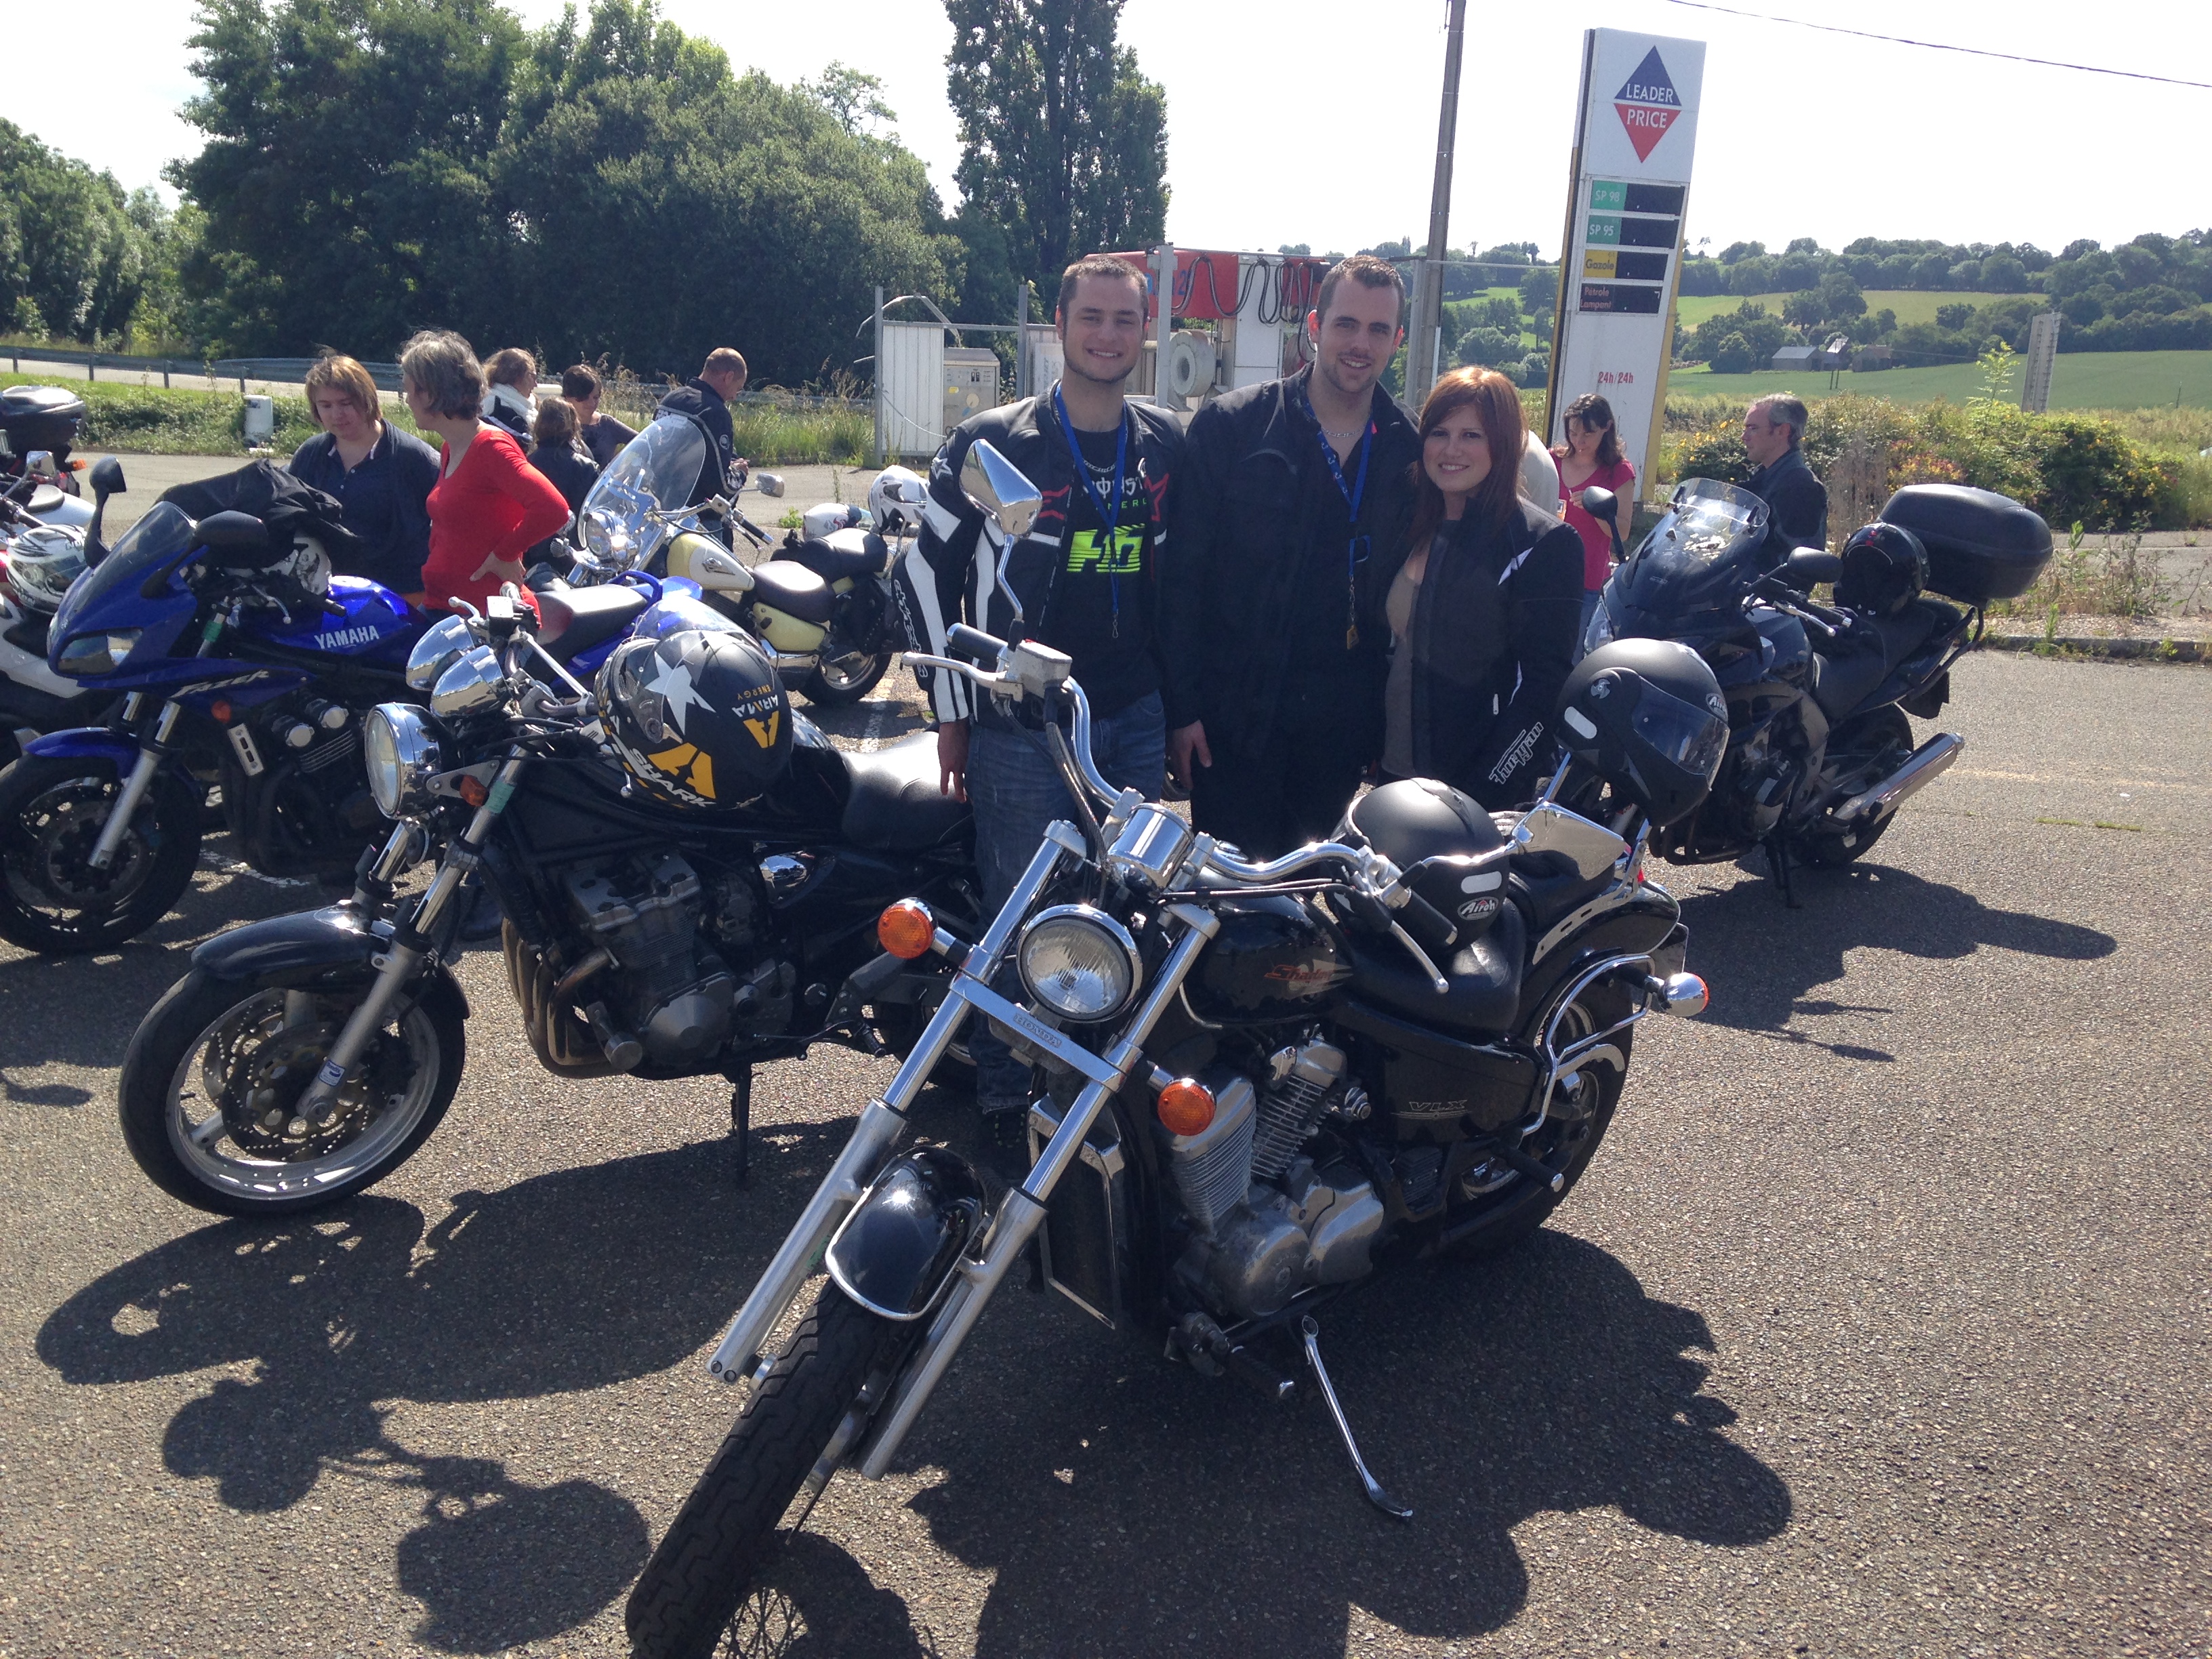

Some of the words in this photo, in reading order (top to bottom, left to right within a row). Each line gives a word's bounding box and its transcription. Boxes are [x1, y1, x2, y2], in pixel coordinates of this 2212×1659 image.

[1626, 83, 1674, 103] LEADER
[1626, 108, 1668, 128] PRICE
[1595, 189, 1607, 201] SP
[1609, 191, 1620, 202] 98
[1589, 224, 1601, 236] SP
[1603, 224, 1614, 237] 95
[1586, 258, 1615, 270] Gazole
[314, 625, 380, 649] YAMAHA
[737, 684, 771, 701] ENERGY
[731, 694, 779, 718] ARMA
[628, 747, 717, 808] SHARK
[1461, 899, 1496, 915] Airoh
[1015, 1014, 1062, 1048] HONDA
[1408, 1099, 1468, 1111] VLX
